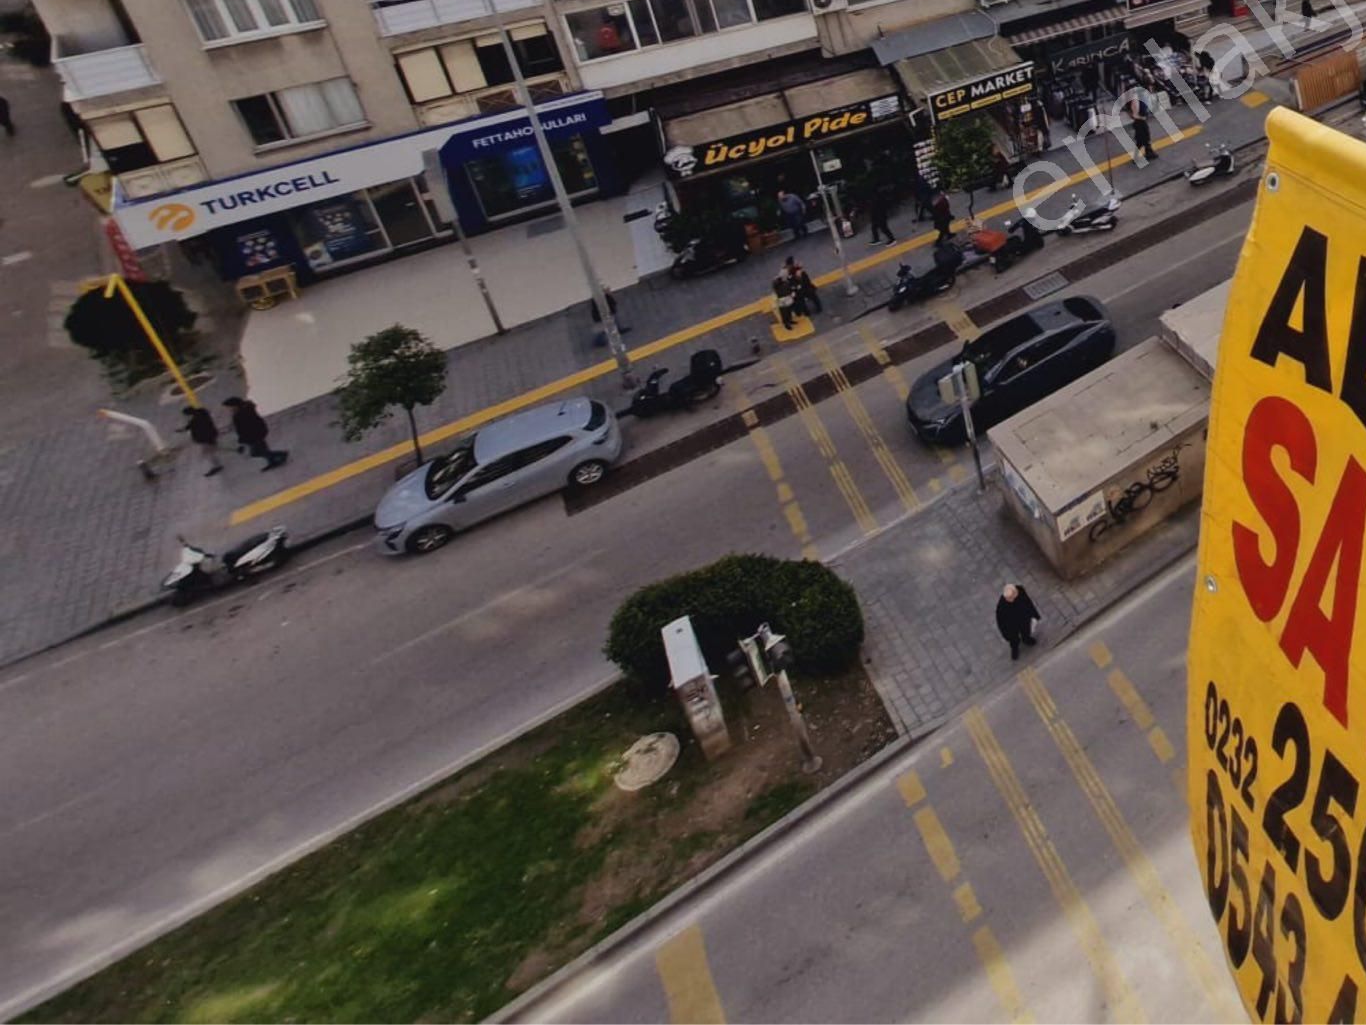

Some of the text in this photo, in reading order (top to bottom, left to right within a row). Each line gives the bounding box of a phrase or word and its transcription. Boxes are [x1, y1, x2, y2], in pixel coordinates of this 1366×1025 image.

[935, 89, 966, 108] CEP
[971, 67, 1034, 97] MARKET
[472, 112, 587, 149] FETTAHOULLARI
[804, 111, 868, 138] Pide
[200, 171, 340, 216] TURKCELL
[1204, 680, 1258, 813] 0232
[1205, 769, 1307, 1025] 0543
